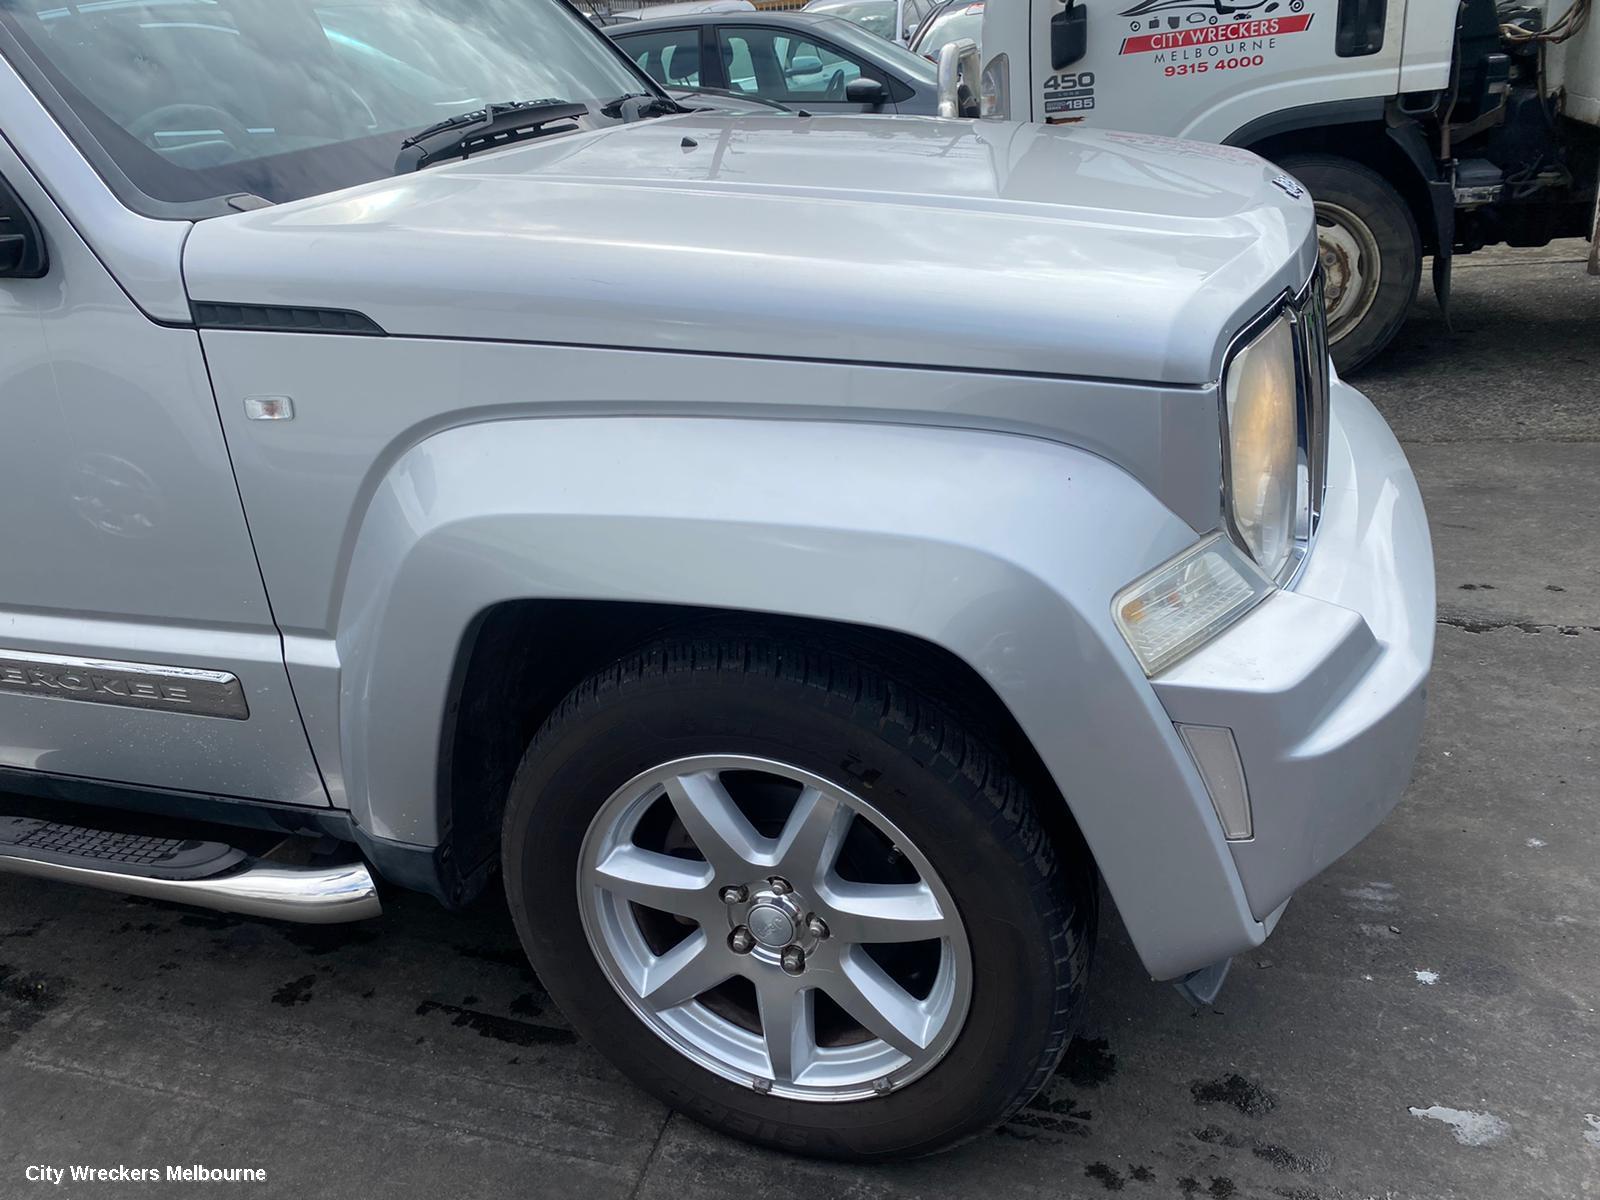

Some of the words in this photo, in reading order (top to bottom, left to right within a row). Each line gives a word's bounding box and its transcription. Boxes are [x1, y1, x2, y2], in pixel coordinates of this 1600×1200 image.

[1150, 31, 1185, 50] CITY
[1190, 18, 1280, 45] WRECKERS
[1154, 38, 1277, 64] MELBOURNE
[1164, 62, 1209, 77] 9315
[1214, 55, 1264, 70] 4000
[1043, 72, 1095, 90] 450
[1066, 98, 1093, 109] 185
